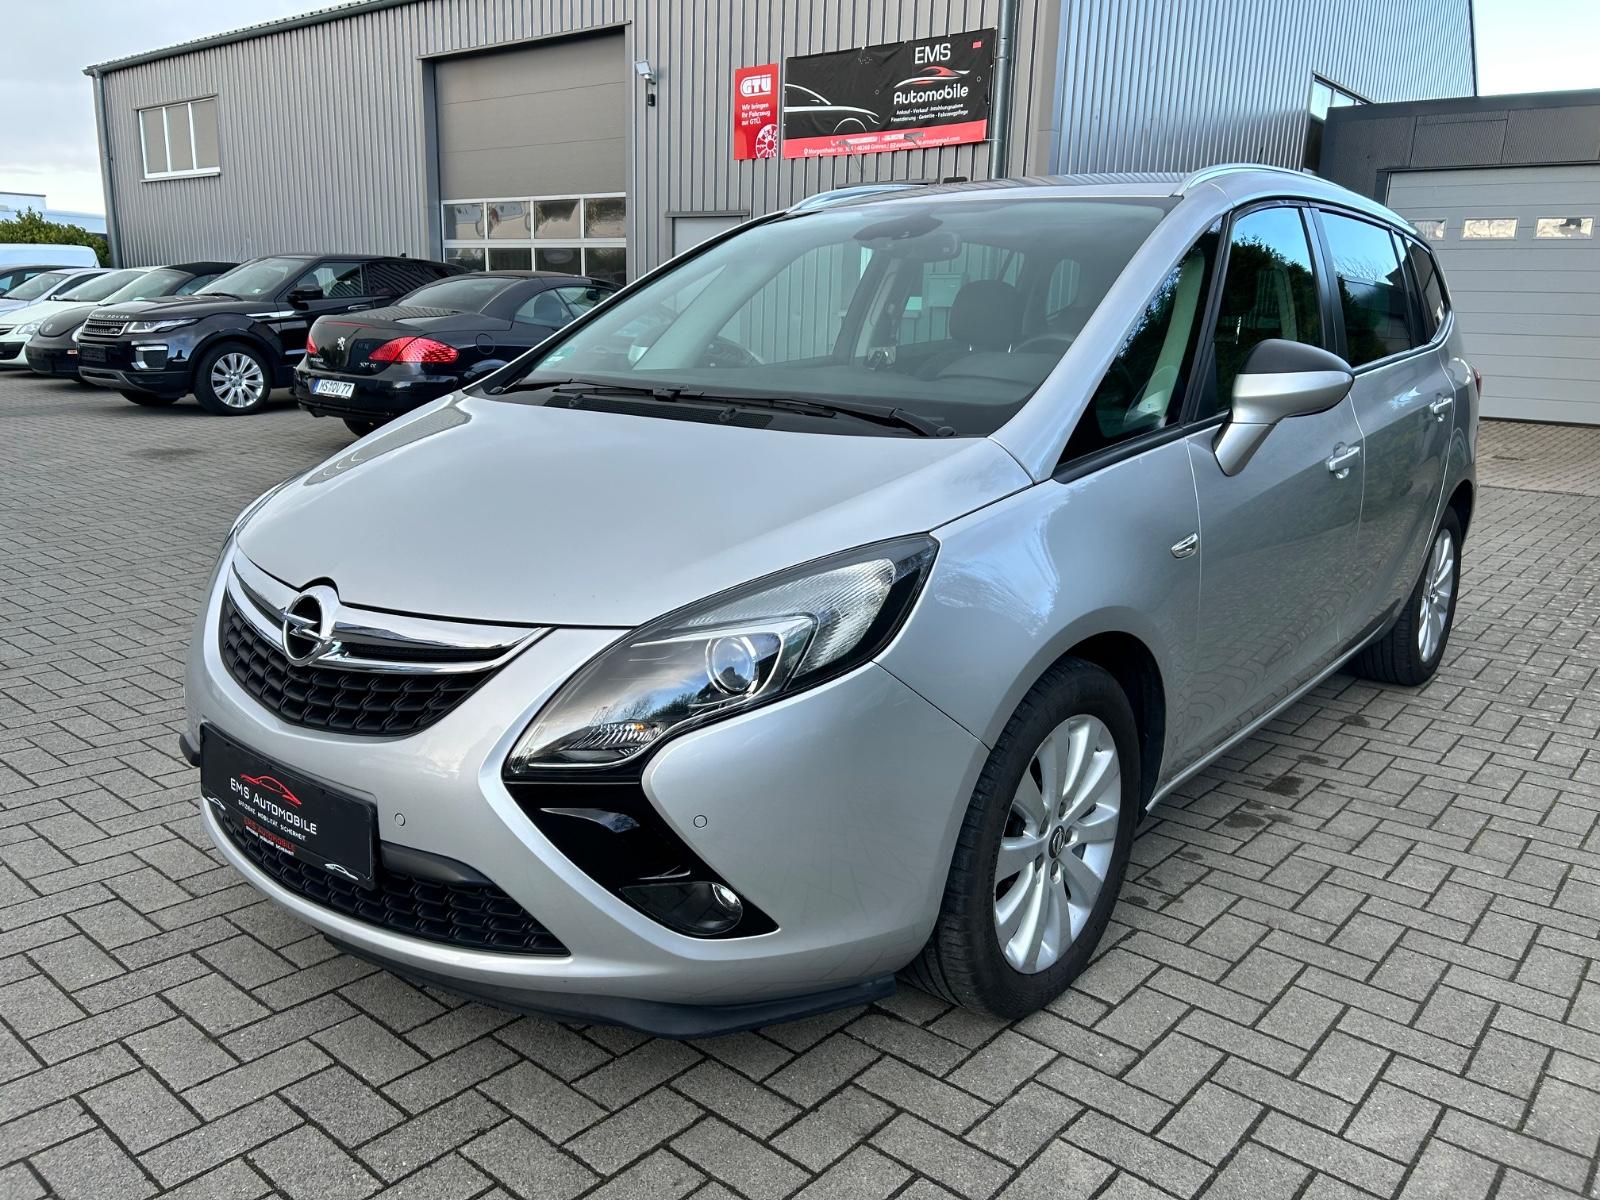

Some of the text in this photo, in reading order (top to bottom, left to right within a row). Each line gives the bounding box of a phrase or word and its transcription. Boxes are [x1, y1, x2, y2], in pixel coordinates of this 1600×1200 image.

[915, 43, 951, 64] EMS
[893, 83, 969, 105] Automobile
[230, 777, 317, 835] EMS AUTOMOBILE
